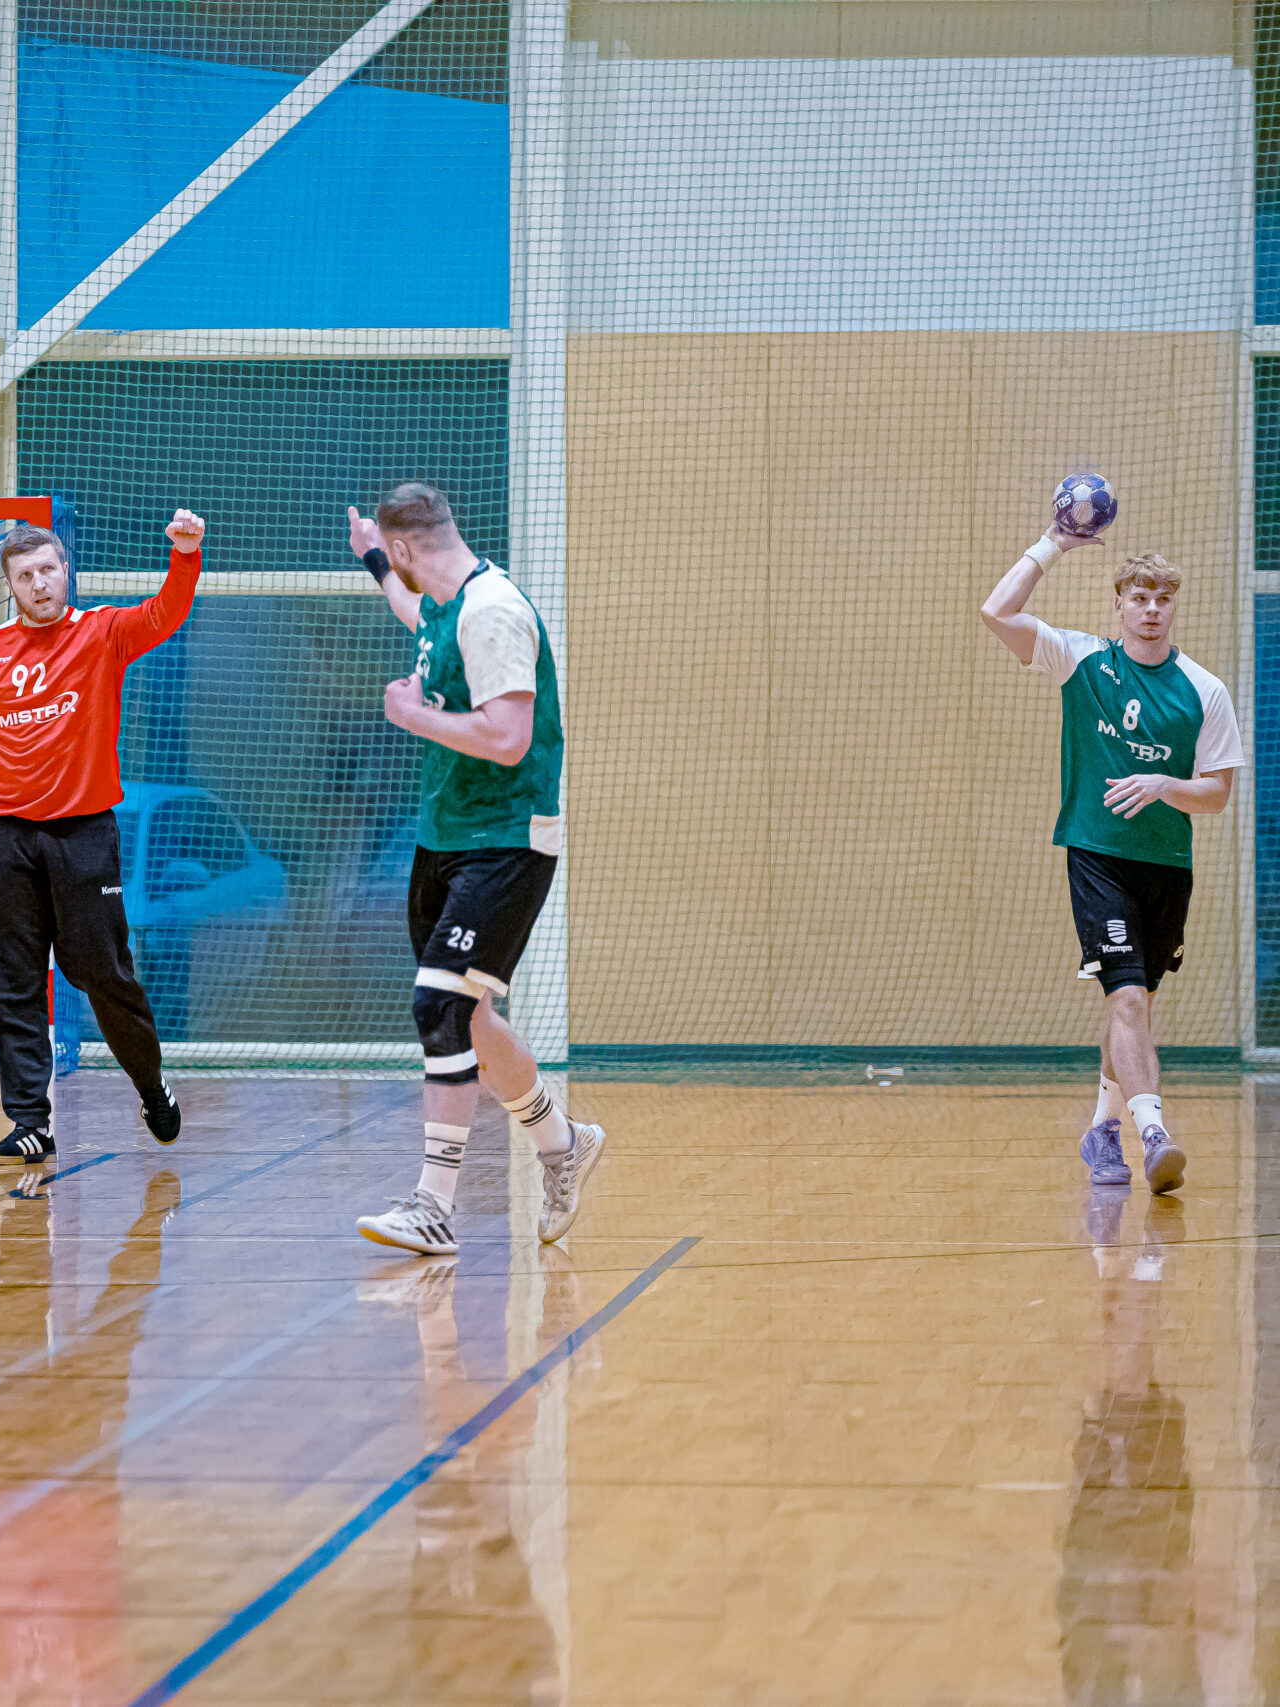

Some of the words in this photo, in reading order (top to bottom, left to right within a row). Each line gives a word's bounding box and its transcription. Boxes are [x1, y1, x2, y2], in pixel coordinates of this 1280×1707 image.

[11, 662, 48, 697] 92
[0, 691, 79, 728] MISTRA
[1122, 699, 1141, 731] 8
[447, 926, 476, 951] 25
[1102, 944, 1133, 954] Kempa
